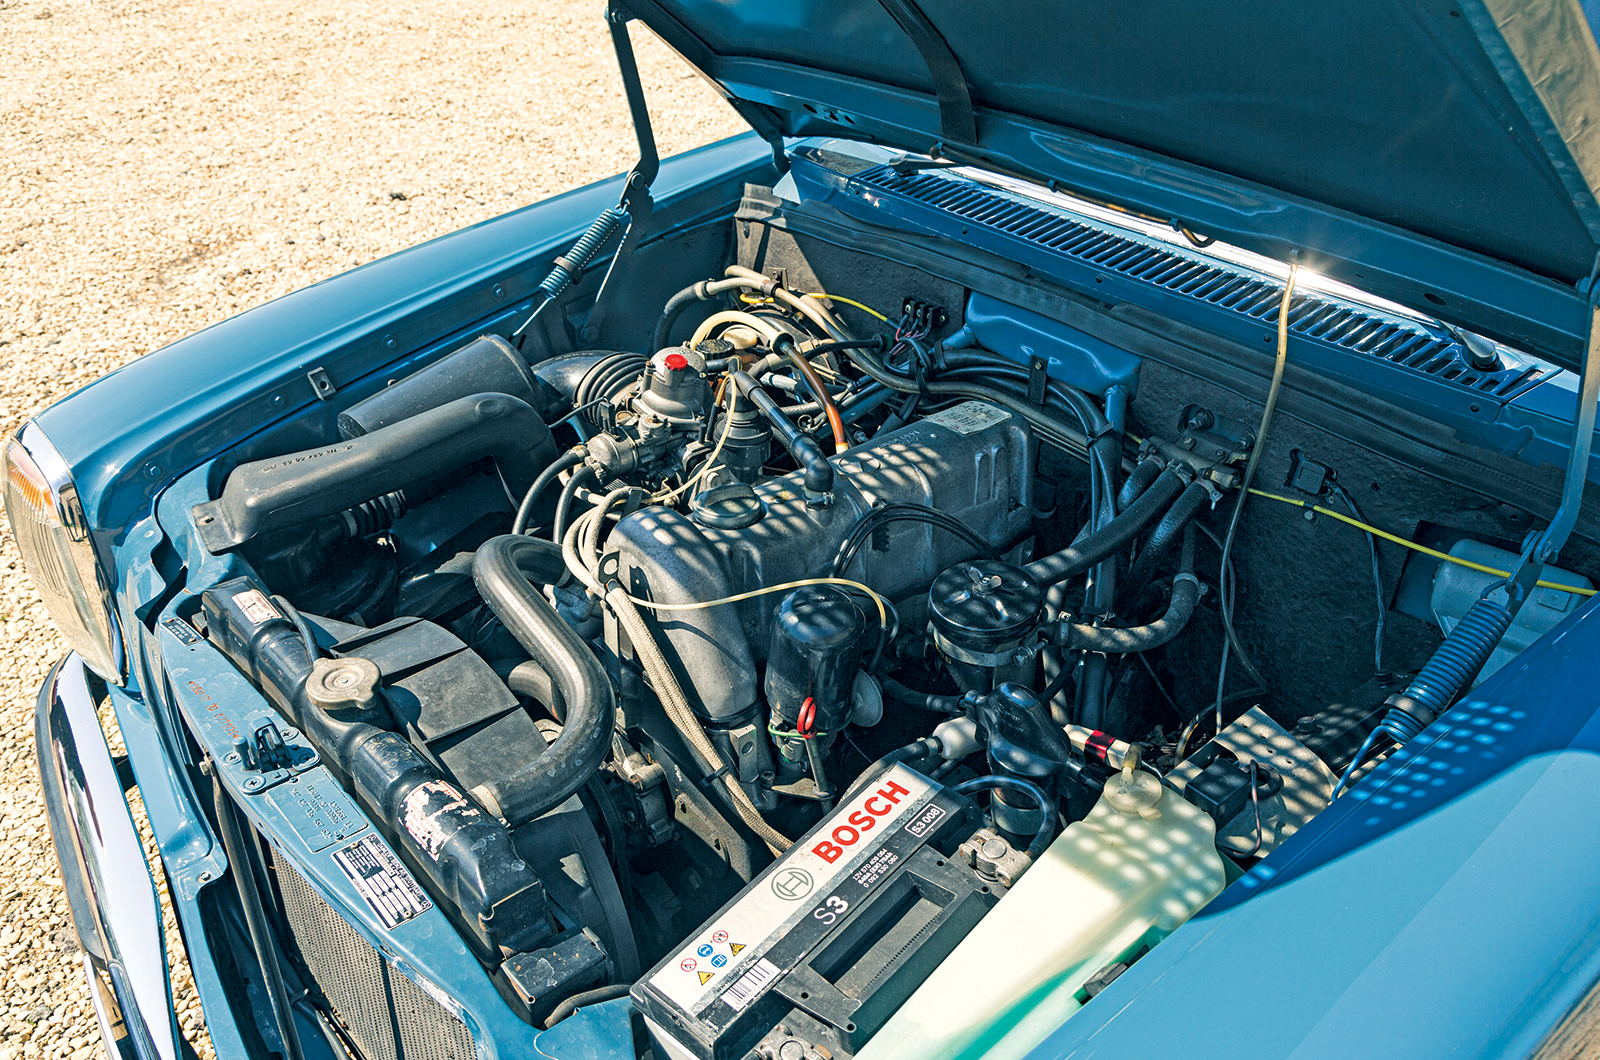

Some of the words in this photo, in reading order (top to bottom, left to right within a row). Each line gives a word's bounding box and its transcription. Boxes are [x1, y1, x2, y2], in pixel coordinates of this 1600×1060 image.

[811, 780, 910, 864] BOSCH
[911, 821, 926, 834] S3
[922, 808, 940, 823] 008
[813, 895, 849, 925] S3
